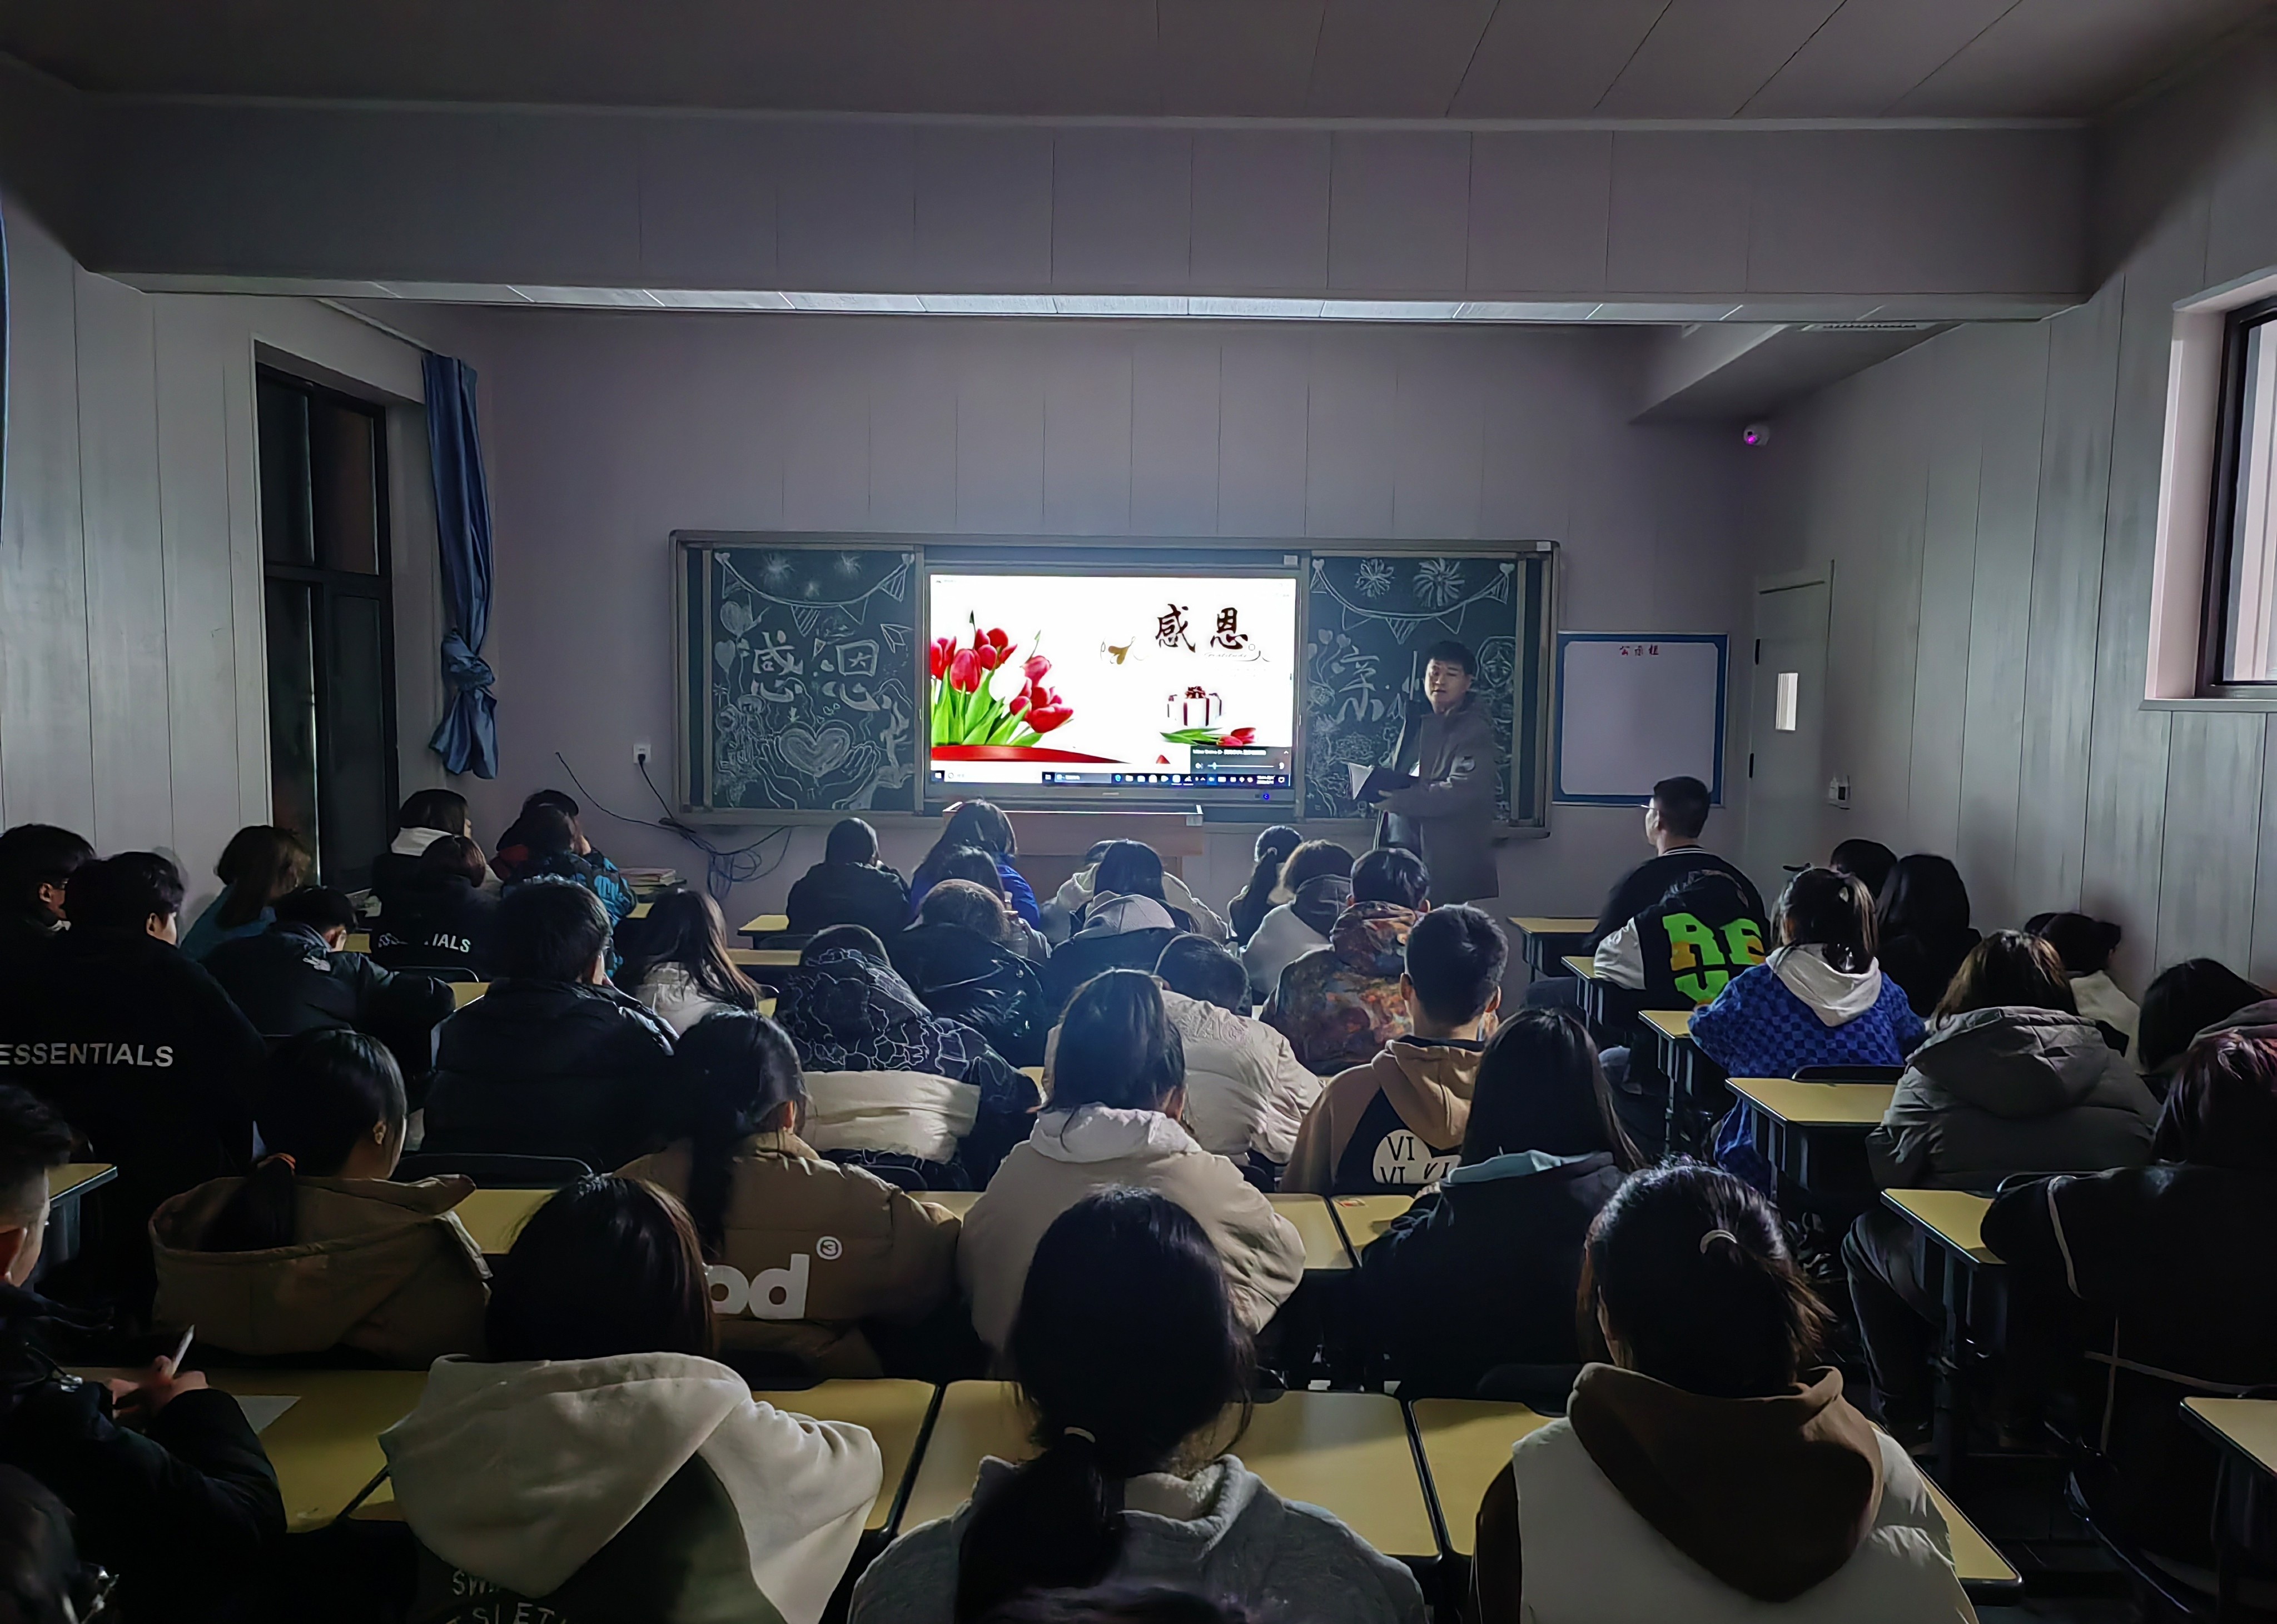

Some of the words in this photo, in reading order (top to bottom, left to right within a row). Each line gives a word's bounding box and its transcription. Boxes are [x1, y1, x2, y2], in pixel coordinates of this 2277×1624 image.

[1155, 604, 1248, 652] 感恩
[752, 630, 892, 711] 感恩
[0, 1043, 173, 1067] ESSENTIALS
[1386, 1135, 1415, 1161] VI
